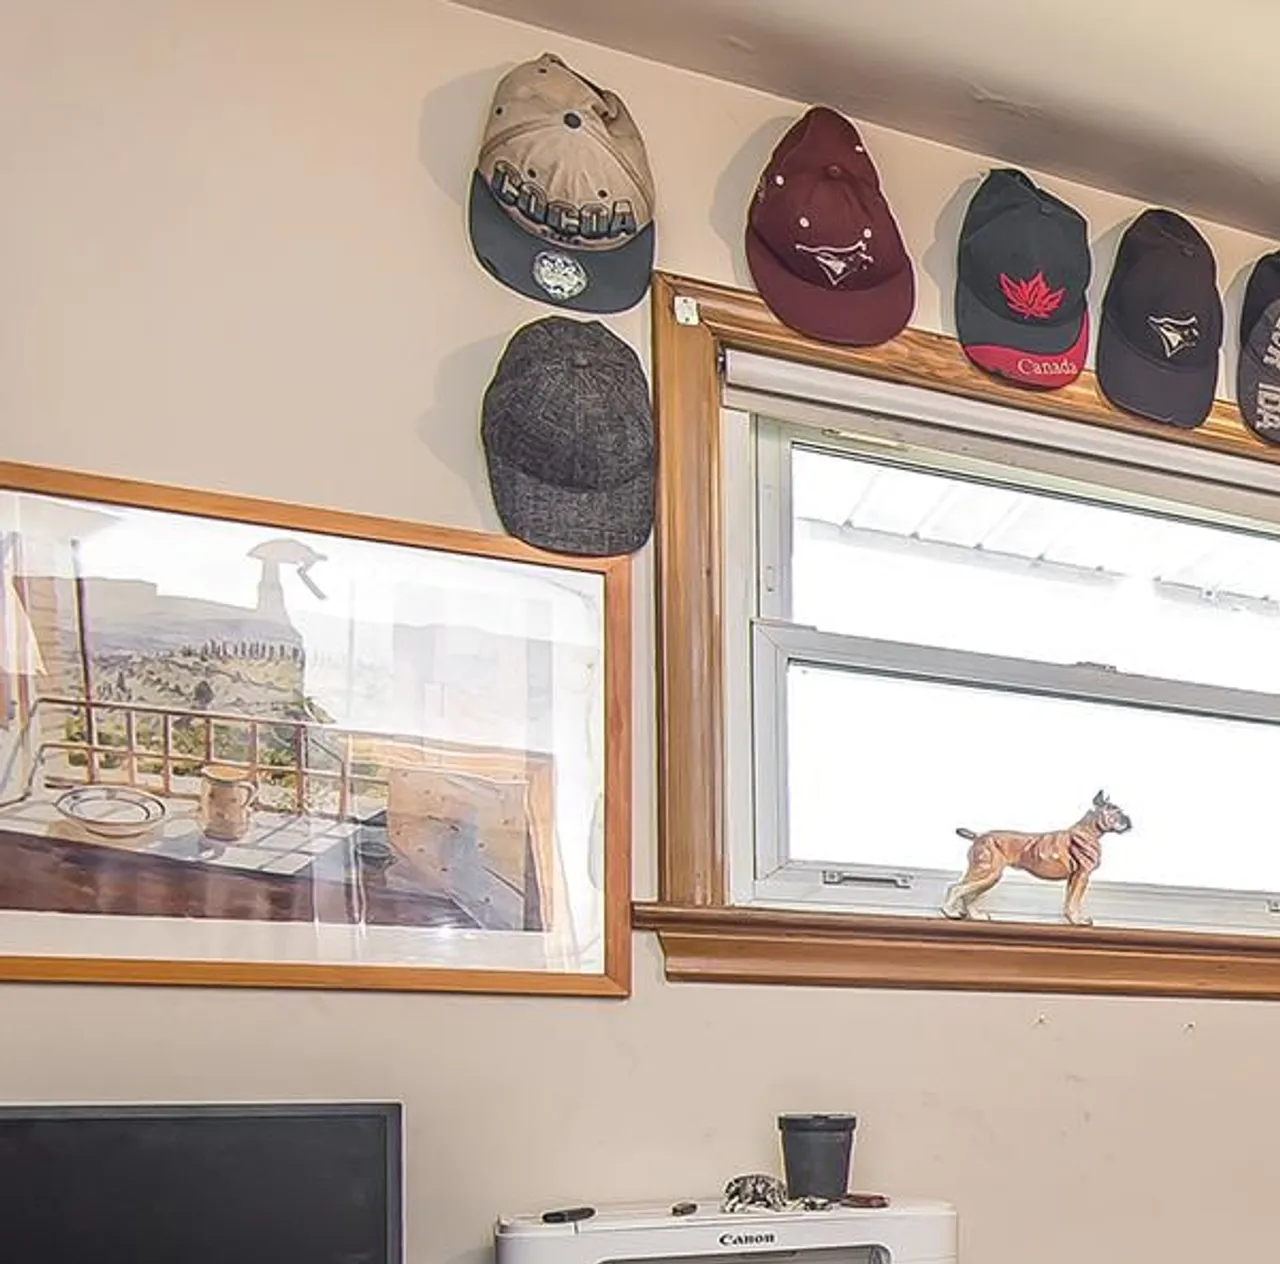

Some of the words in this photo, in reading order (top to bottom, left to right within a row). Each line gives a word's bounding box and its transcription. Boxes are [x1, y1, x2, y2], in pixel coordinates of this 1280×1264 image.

[491, 160, 637, 240] COCOA
[1017, 358, 1078, 375] Canada
[719, 1233, 775, 1246] Canon
